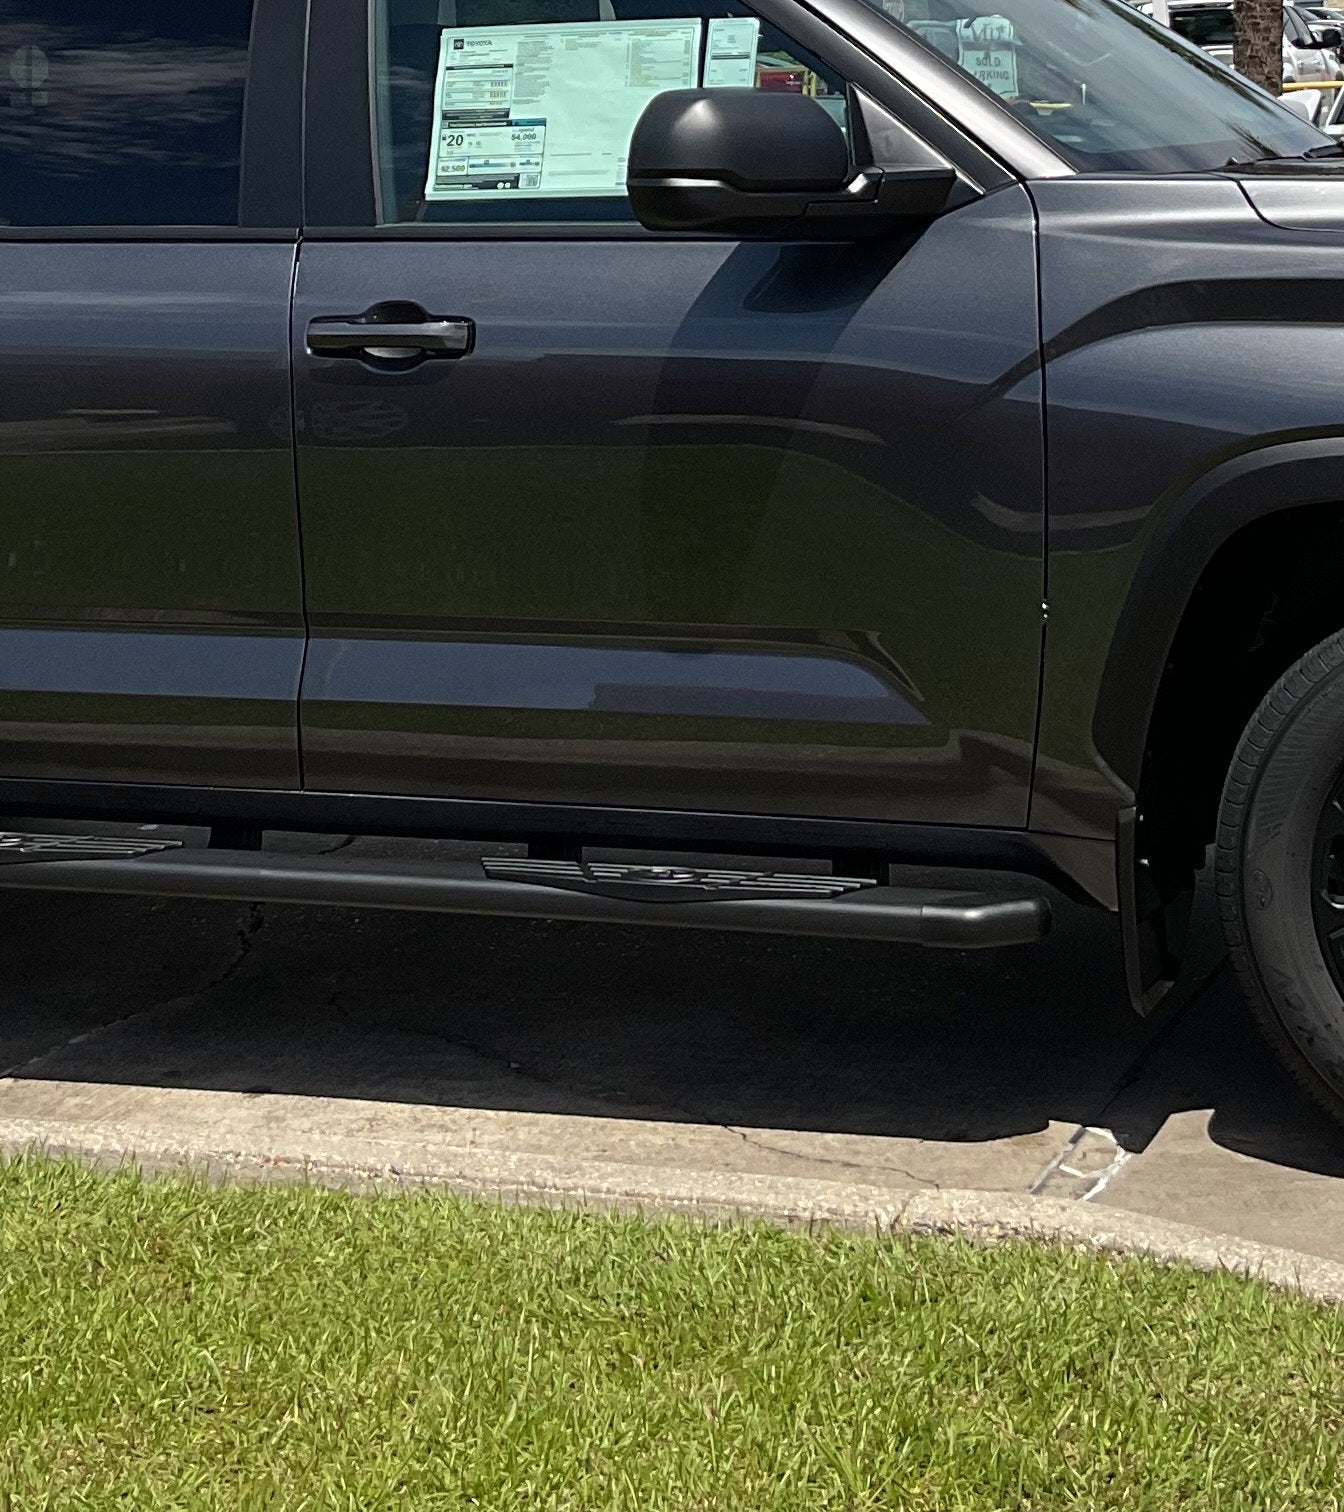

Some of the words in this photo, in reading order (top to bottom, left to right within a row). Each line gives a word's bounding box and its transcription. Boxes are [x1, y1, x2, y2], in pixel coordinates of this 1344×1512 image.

[975, 56, 1001, 66] SOLD
[973, 69, 1009, 81] RKING
[446, 134, 464, 147] 20
